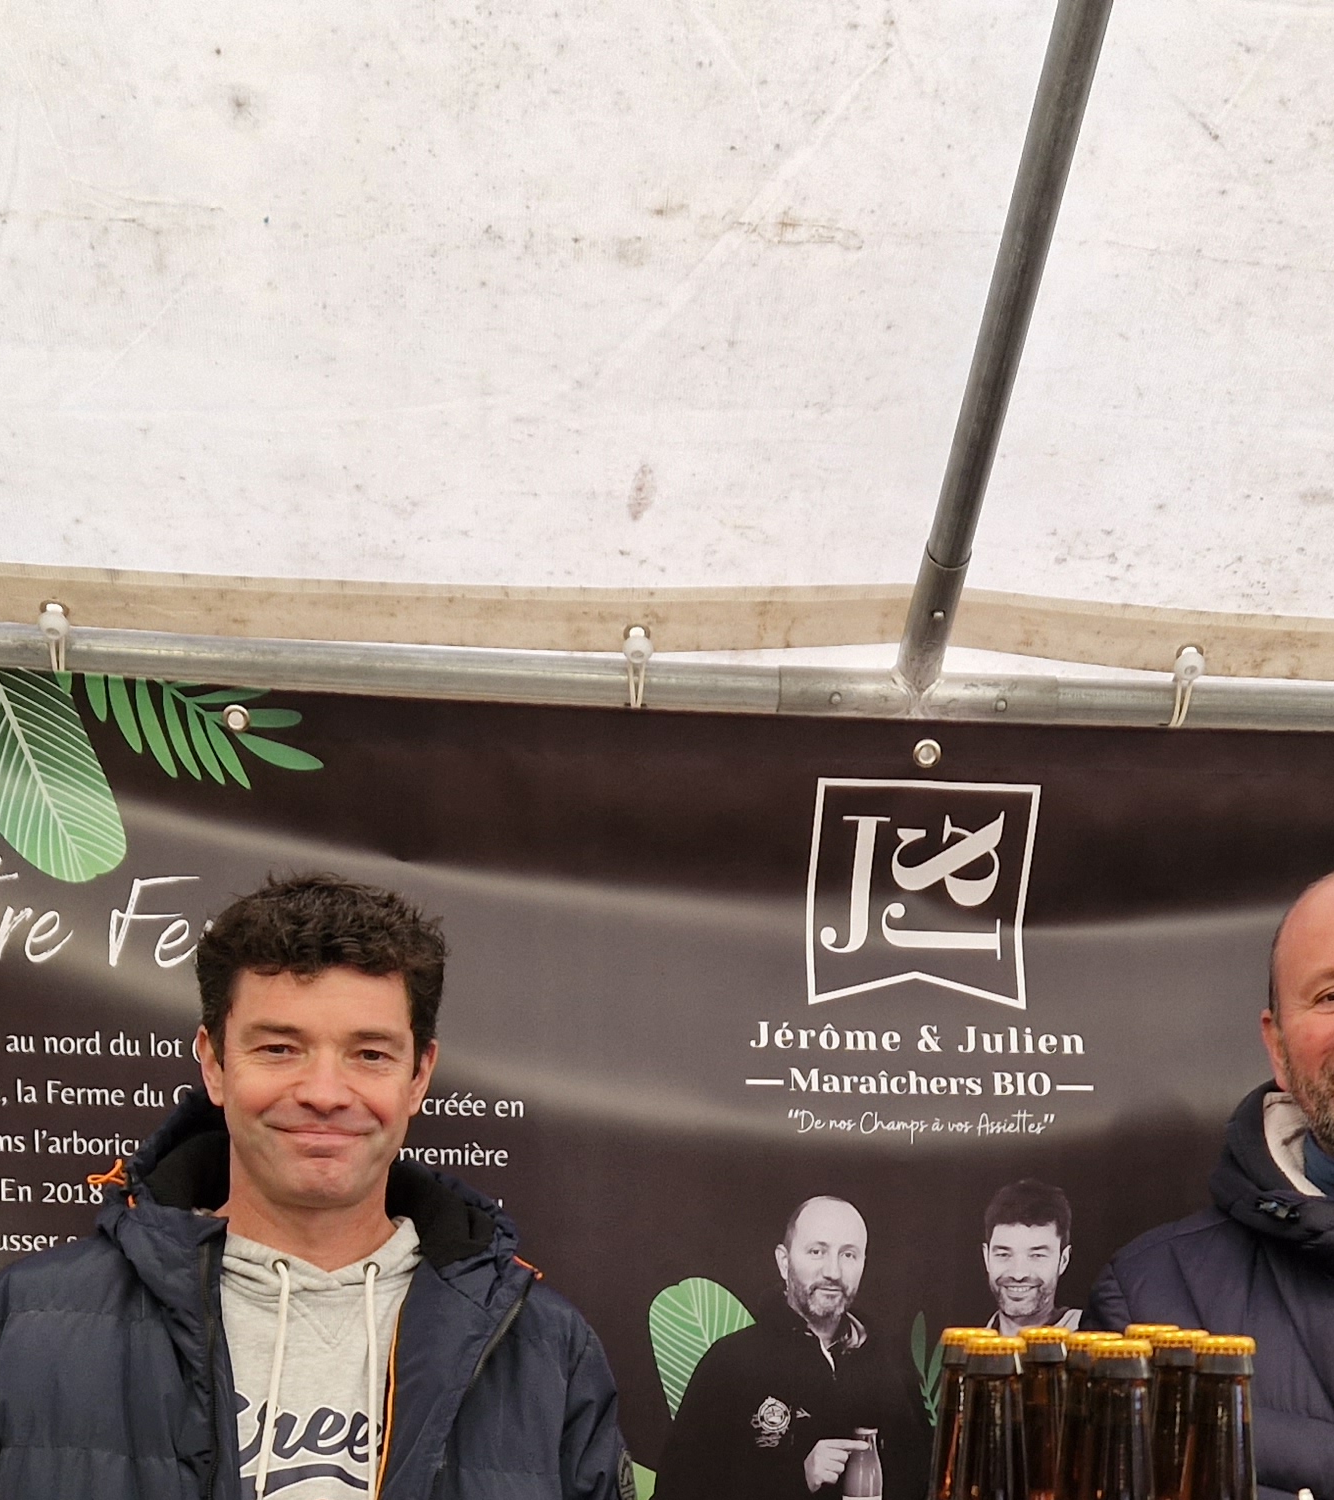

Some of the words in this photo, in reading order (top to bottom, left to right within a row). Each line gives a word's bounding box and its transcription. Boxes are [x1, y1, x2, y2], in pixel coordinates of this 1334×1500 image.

[5, 1034, 36, 1055] au
[44, 1031, 102, 1057] nord
[109, 1031, 142, 1057] du
[149, 1031, 183, 1058] lot
[750, 1020, 902, 1052] Jérôme
[916, 1024, 943, 1053] &
[957, 1025, 1086, 1055] Julien
[16, 1079, 38, 1105] la
[46, 1080, 126, 1107] Ferme
[133, 1081, 166, 1109] du
[787, 1066, 983, 1096] Maraîchers
[992, 1071, 1052, 1097] BIO
[421, 1091, 487, 1118] créée
[494, 1099, 525, 1119] en
[828, 1116, 857, 1132] nos
[859, 1111, 929, 1145] Champs
[930, 1115, 945, 1132] à
[948, 1119, 973, 1133] vos
[0, 1177, 34, 1204] En
[40, 1180, 104, 1206] 2018
